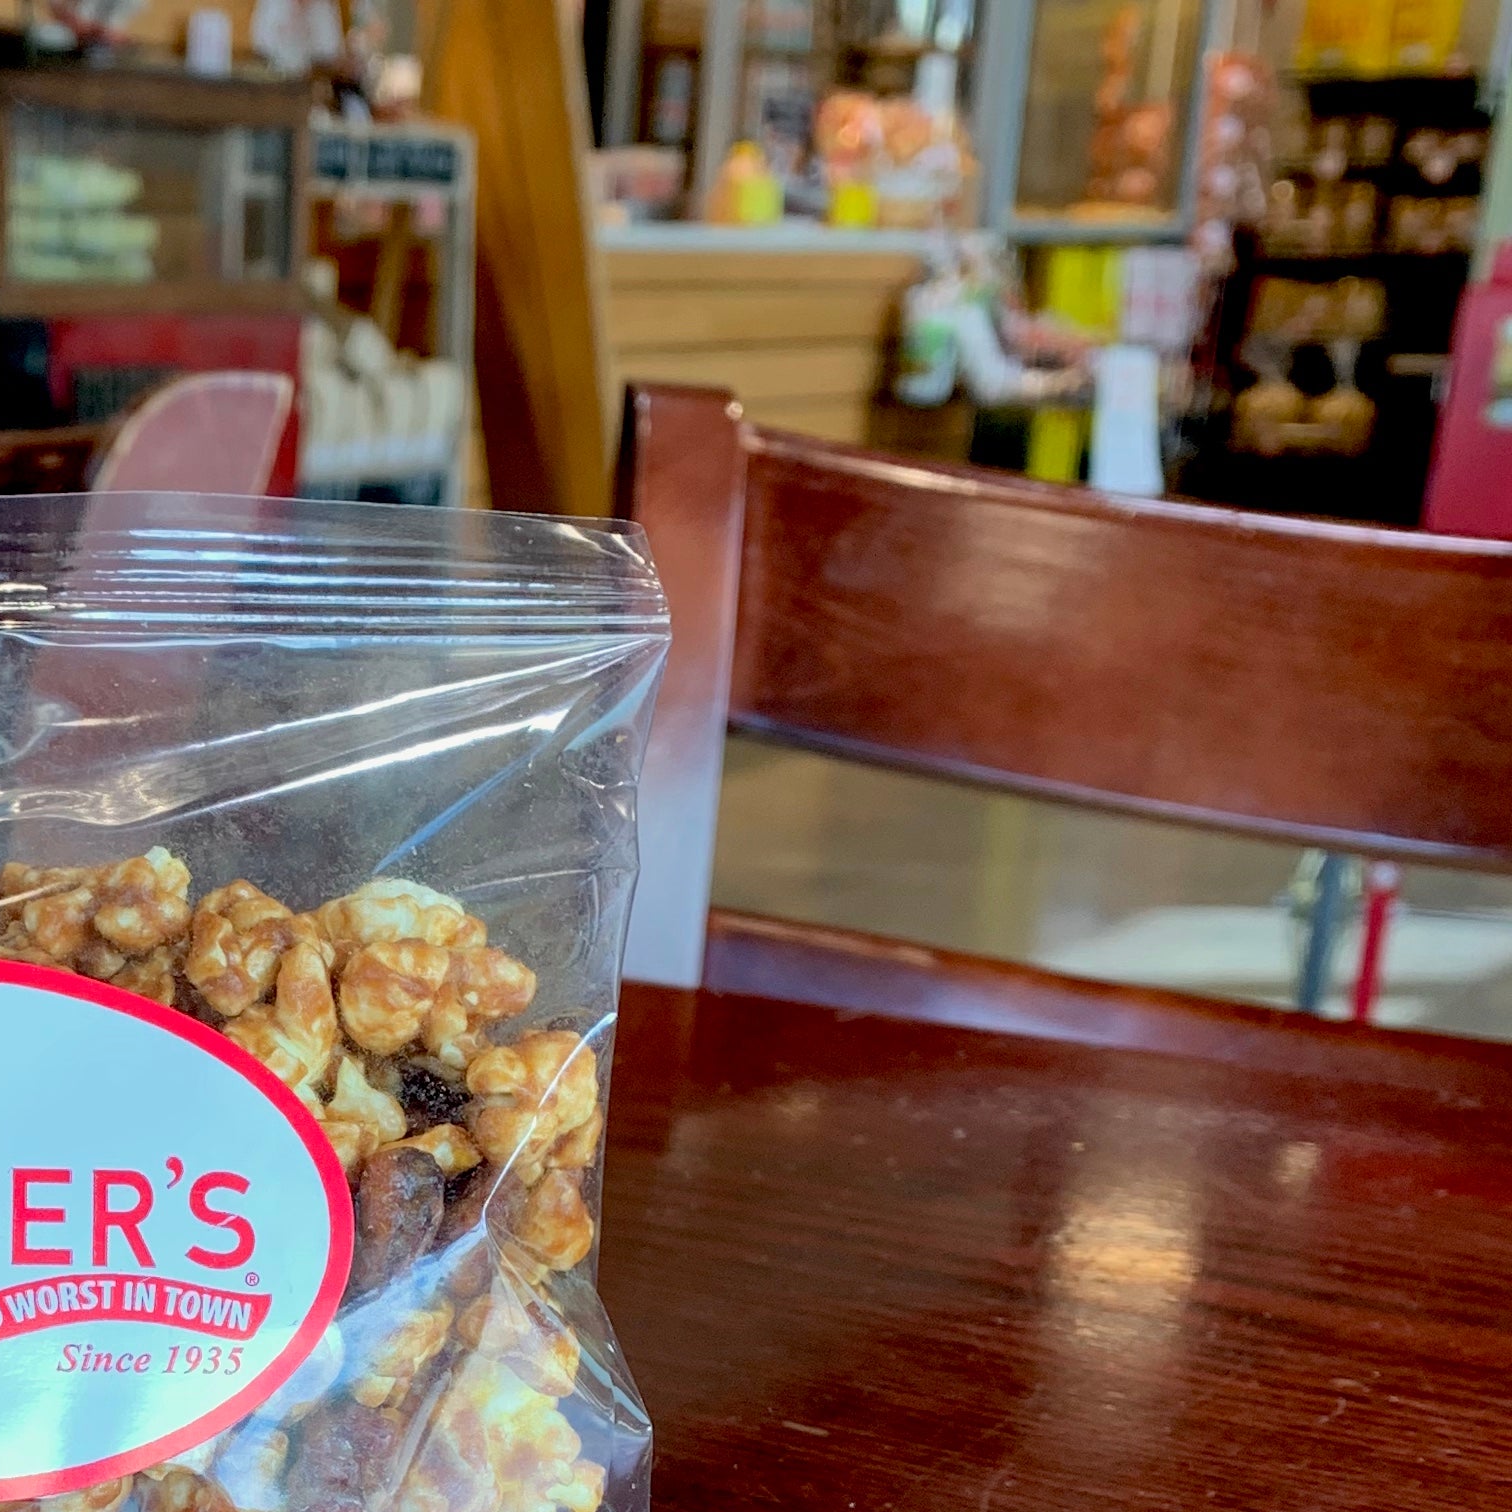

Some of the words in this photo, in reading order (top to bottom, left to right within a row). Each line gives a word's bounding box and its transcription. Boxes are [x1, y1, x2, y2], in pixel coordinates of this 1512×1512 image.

[5, 1280, 116, 1323] WORST
[122, 1281, 155, 1313] IN
[163, 1286, 252, 1331] TOWN
[57, 1343, 150, 1374] Since
[161, 1345, 245, 1375] 1935
